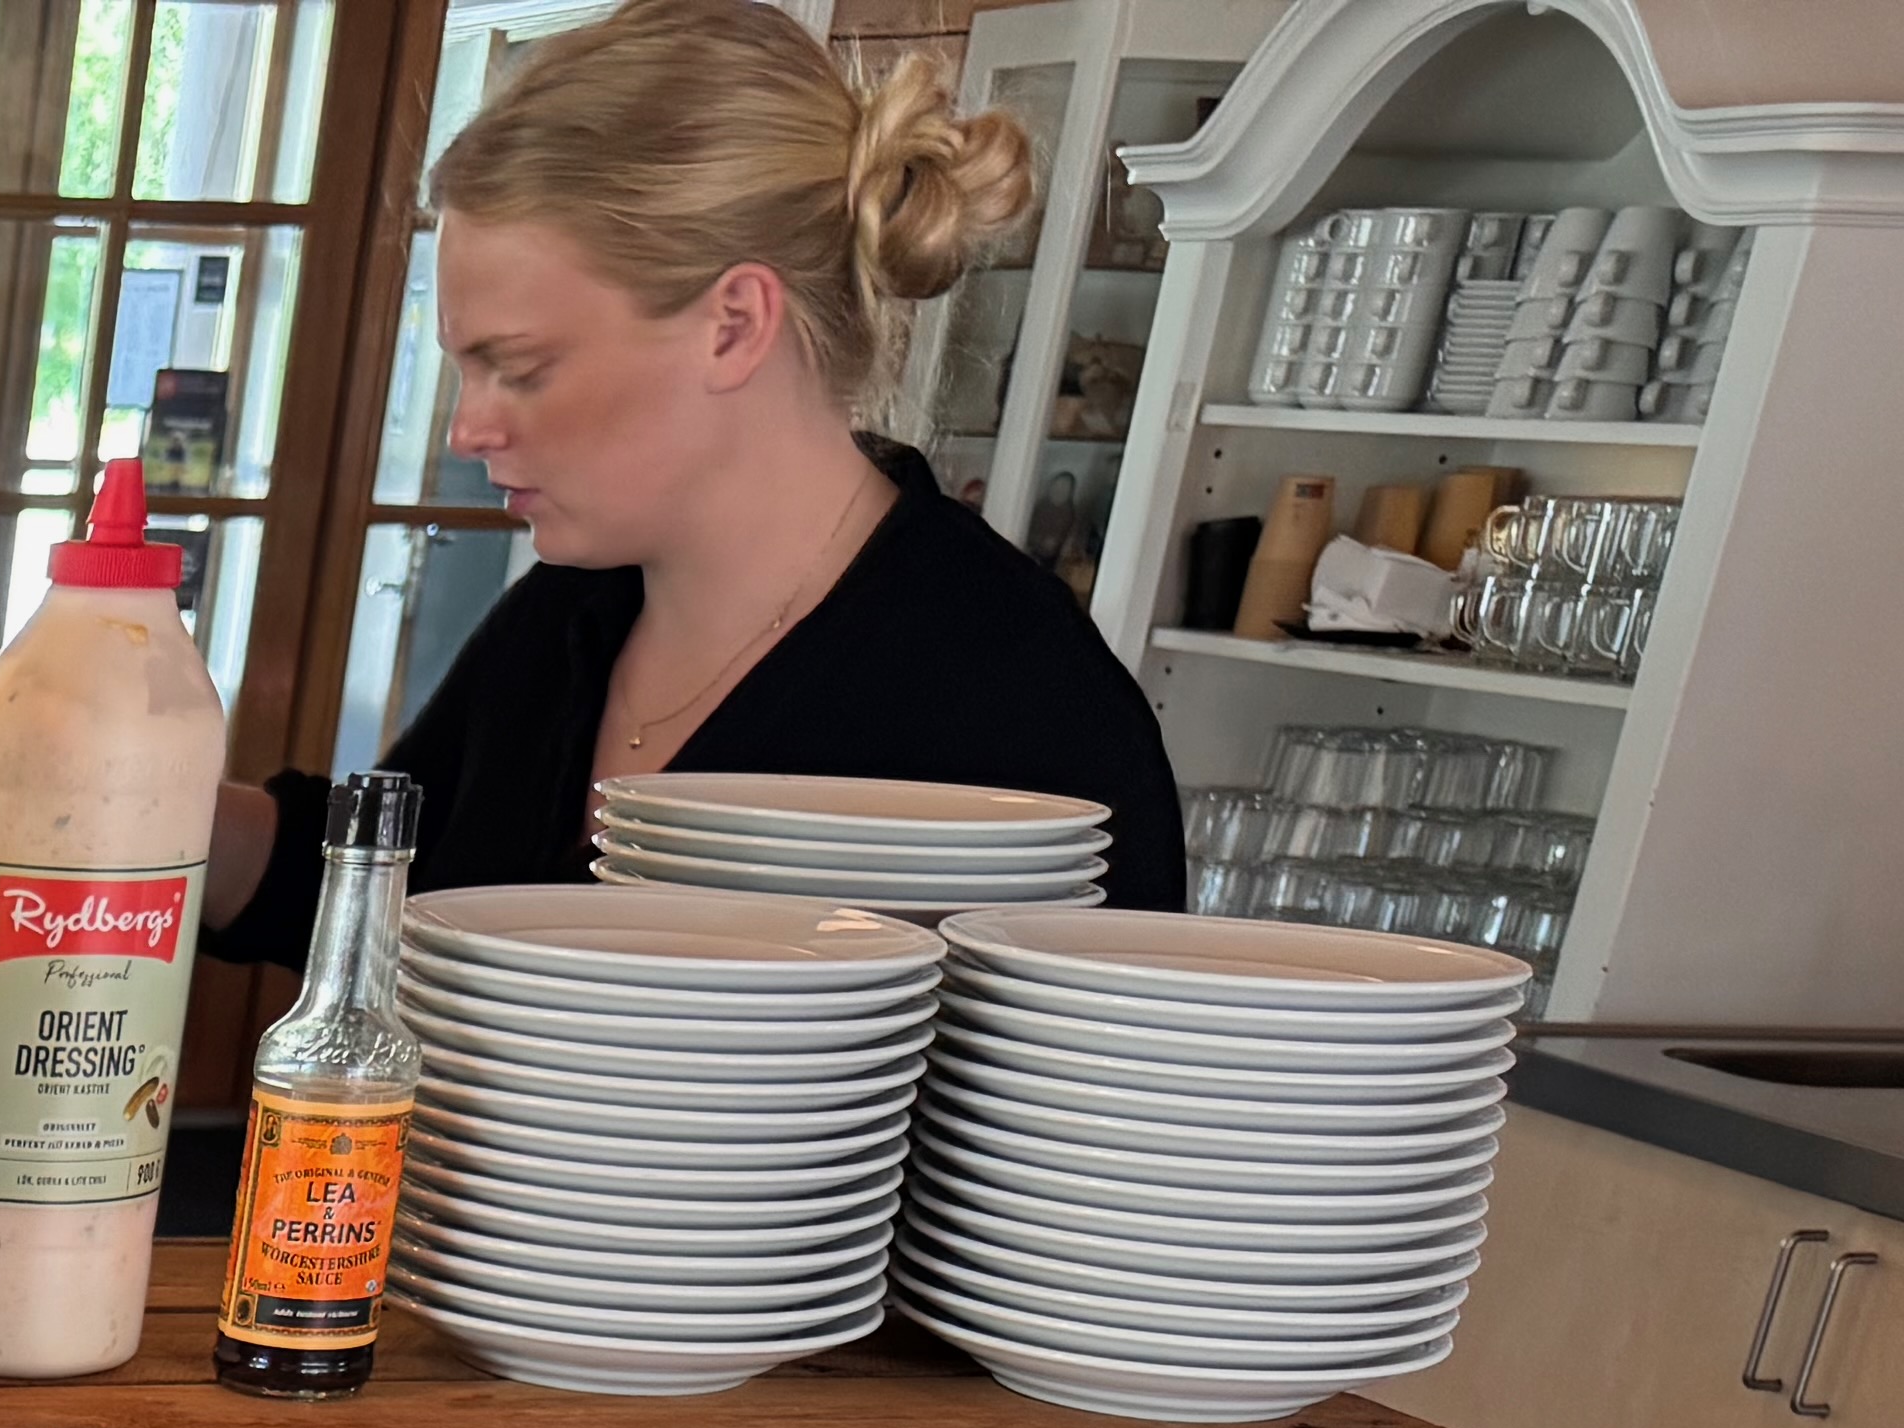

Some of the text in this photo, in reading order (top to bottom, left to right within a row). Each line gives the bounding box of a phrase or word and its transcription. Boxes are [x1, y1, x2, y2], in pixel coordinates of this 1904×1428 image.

[3, 889, 173, 948] Rydbergs
[38, 1009, 128, 1042] ORIENT
[15, 1044, 137, 1078] DRESSING
[295, 1168, 344, 1178] ORIGINAL
[306, 1181, 356, 1203] LEA
[323, 1206, 334, 1220] &
[272, 1219, 376, 1244] PERRINS
[261, 1241, 381, 1271] WORCESTERSHIRE
[296, 1271, 343, 1286] SAUCE
